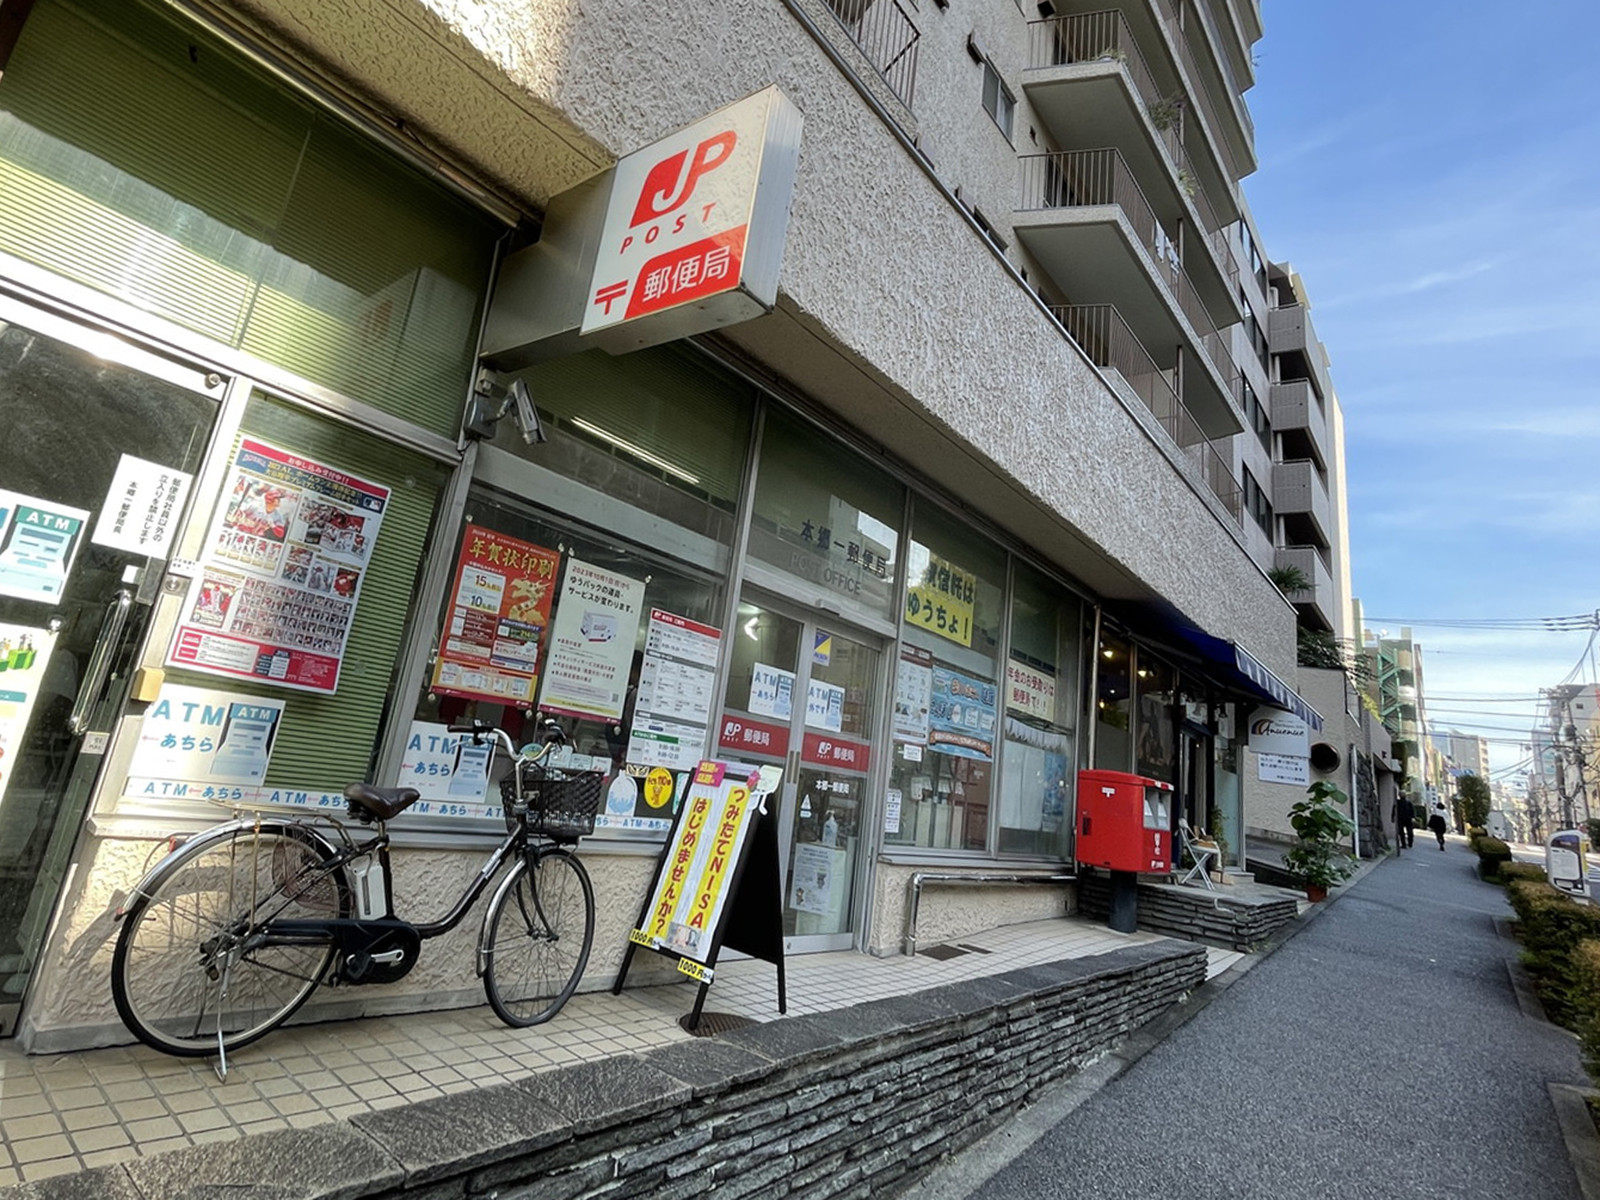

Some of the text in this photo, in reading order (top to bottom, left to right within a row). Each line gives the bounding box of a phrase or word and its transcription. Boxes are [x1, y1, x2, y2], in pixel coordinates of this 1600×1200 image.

[629, 131, 737, 229] JP
[620, 202, 716, 255] POST
[642, 245, 731, 302] 郵便局
[26, 511, 70, 531] ATM
[468, 536, 555, 580] 年賀状印刷
[824, 567, 861, 596] OFFICE
[907, 592, 969, 640] ゆうちょ!
[754, 671, 777, 687] ATM
[808, 686, 828, 700] ATM
[152, 699, 226, 727] ATM
[237, 706, 272, 721] ATM
[159, 733, 214, 753] あちら
[408, 733, 458, 755] ATM
[414, 761, 451, 777] あちら
[143, 782, 189, 796] ATM
[202, 785, 243, 800] あちら
[269, 790, 308, 805] ATM
[404, 802, 431, 813] TM
[438, 804, 467, 815] あちら
[623, 819, 643, 827] ATM
[656, 797, 708, 935] はじめませんか?
[689, 788, 748, 929] つみたてNISA
